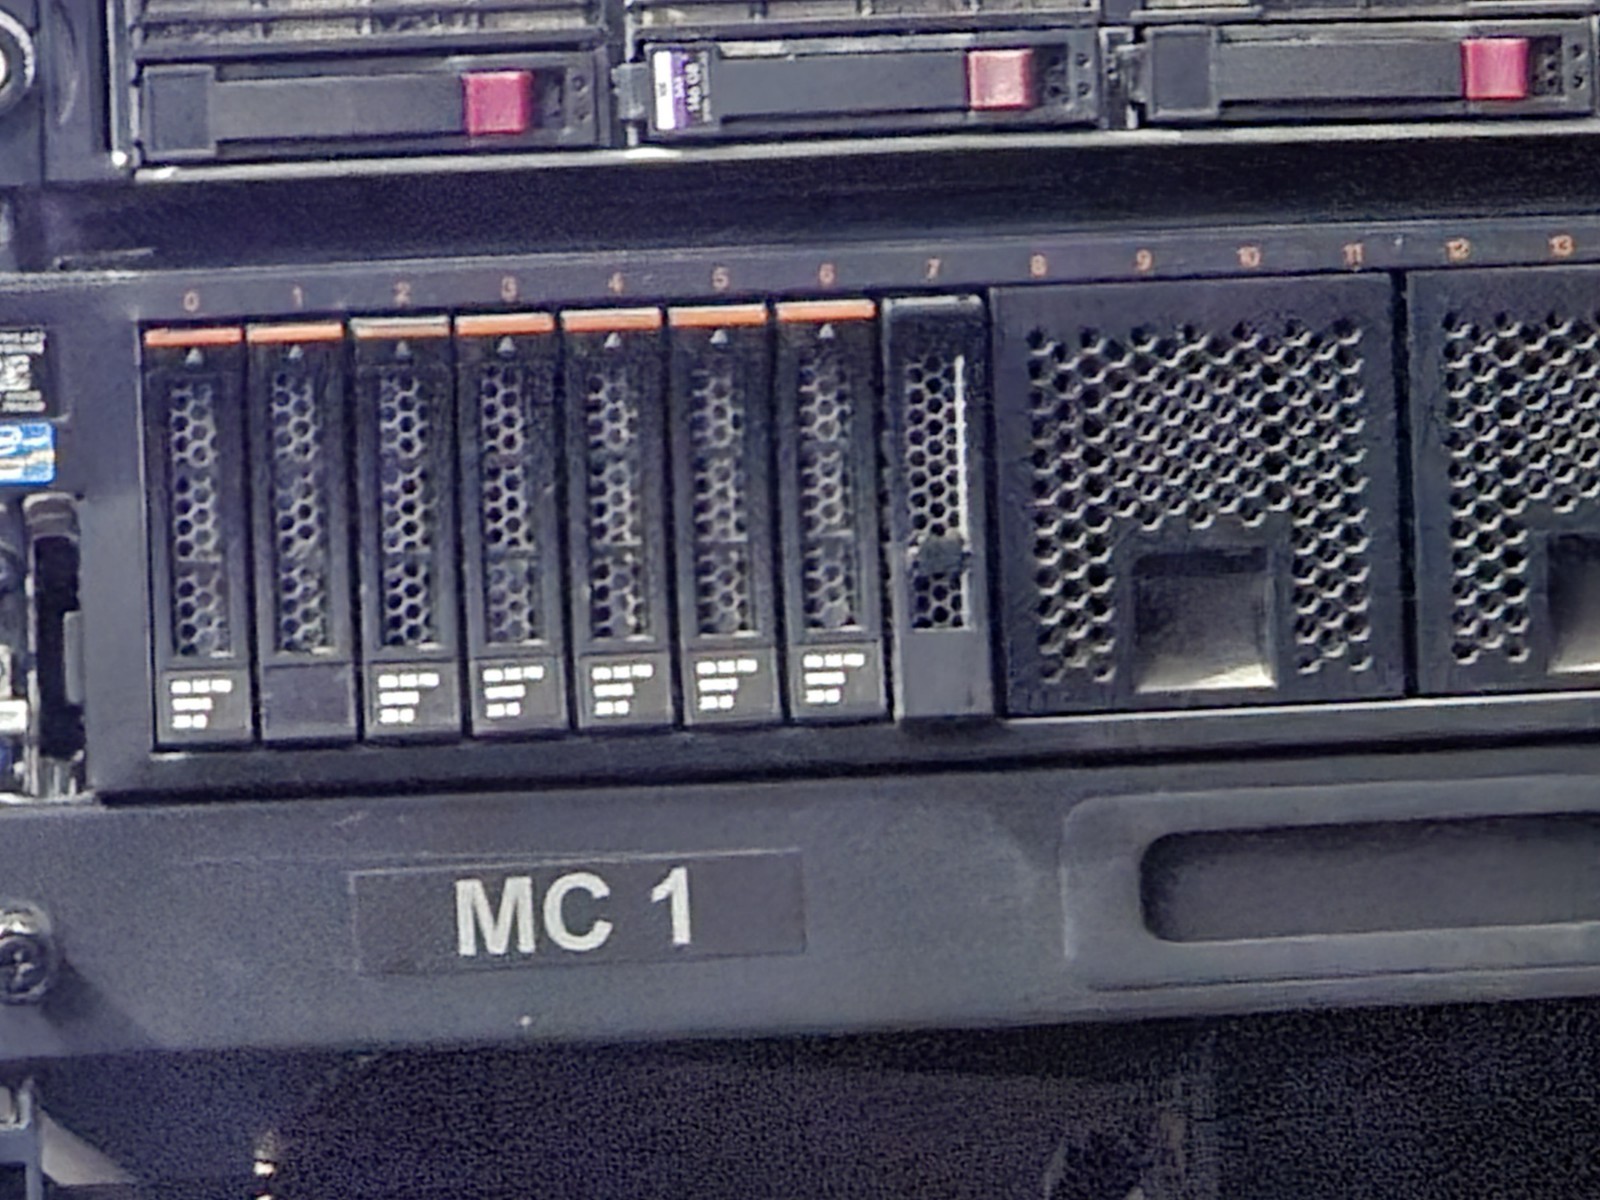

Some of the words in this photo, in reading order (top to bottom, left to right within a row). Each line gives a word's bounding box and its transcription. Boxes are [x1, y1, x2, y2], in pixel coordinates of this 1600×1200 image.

[1237, 246, 1260, 268] 10
[1344, 243, 1364, 265] 11
[1446, 238, 1471, 262] 12
[1549, 235, 1574, 257] 13
[927, 258, 941, 279] 7
[1031, 254, 1047, 276] 8
[1136, 249, 1152, 271] 9
[608, 272, 623, 293] 4
[713, 267, 729, 290] 5
[820, 263, 834, 285] 6
[184, 291, 199, 312] 0
[394, 282, 410, 304] 2
[455, 872, 613, 956] MC
[651, 866, 692, 945] 1
